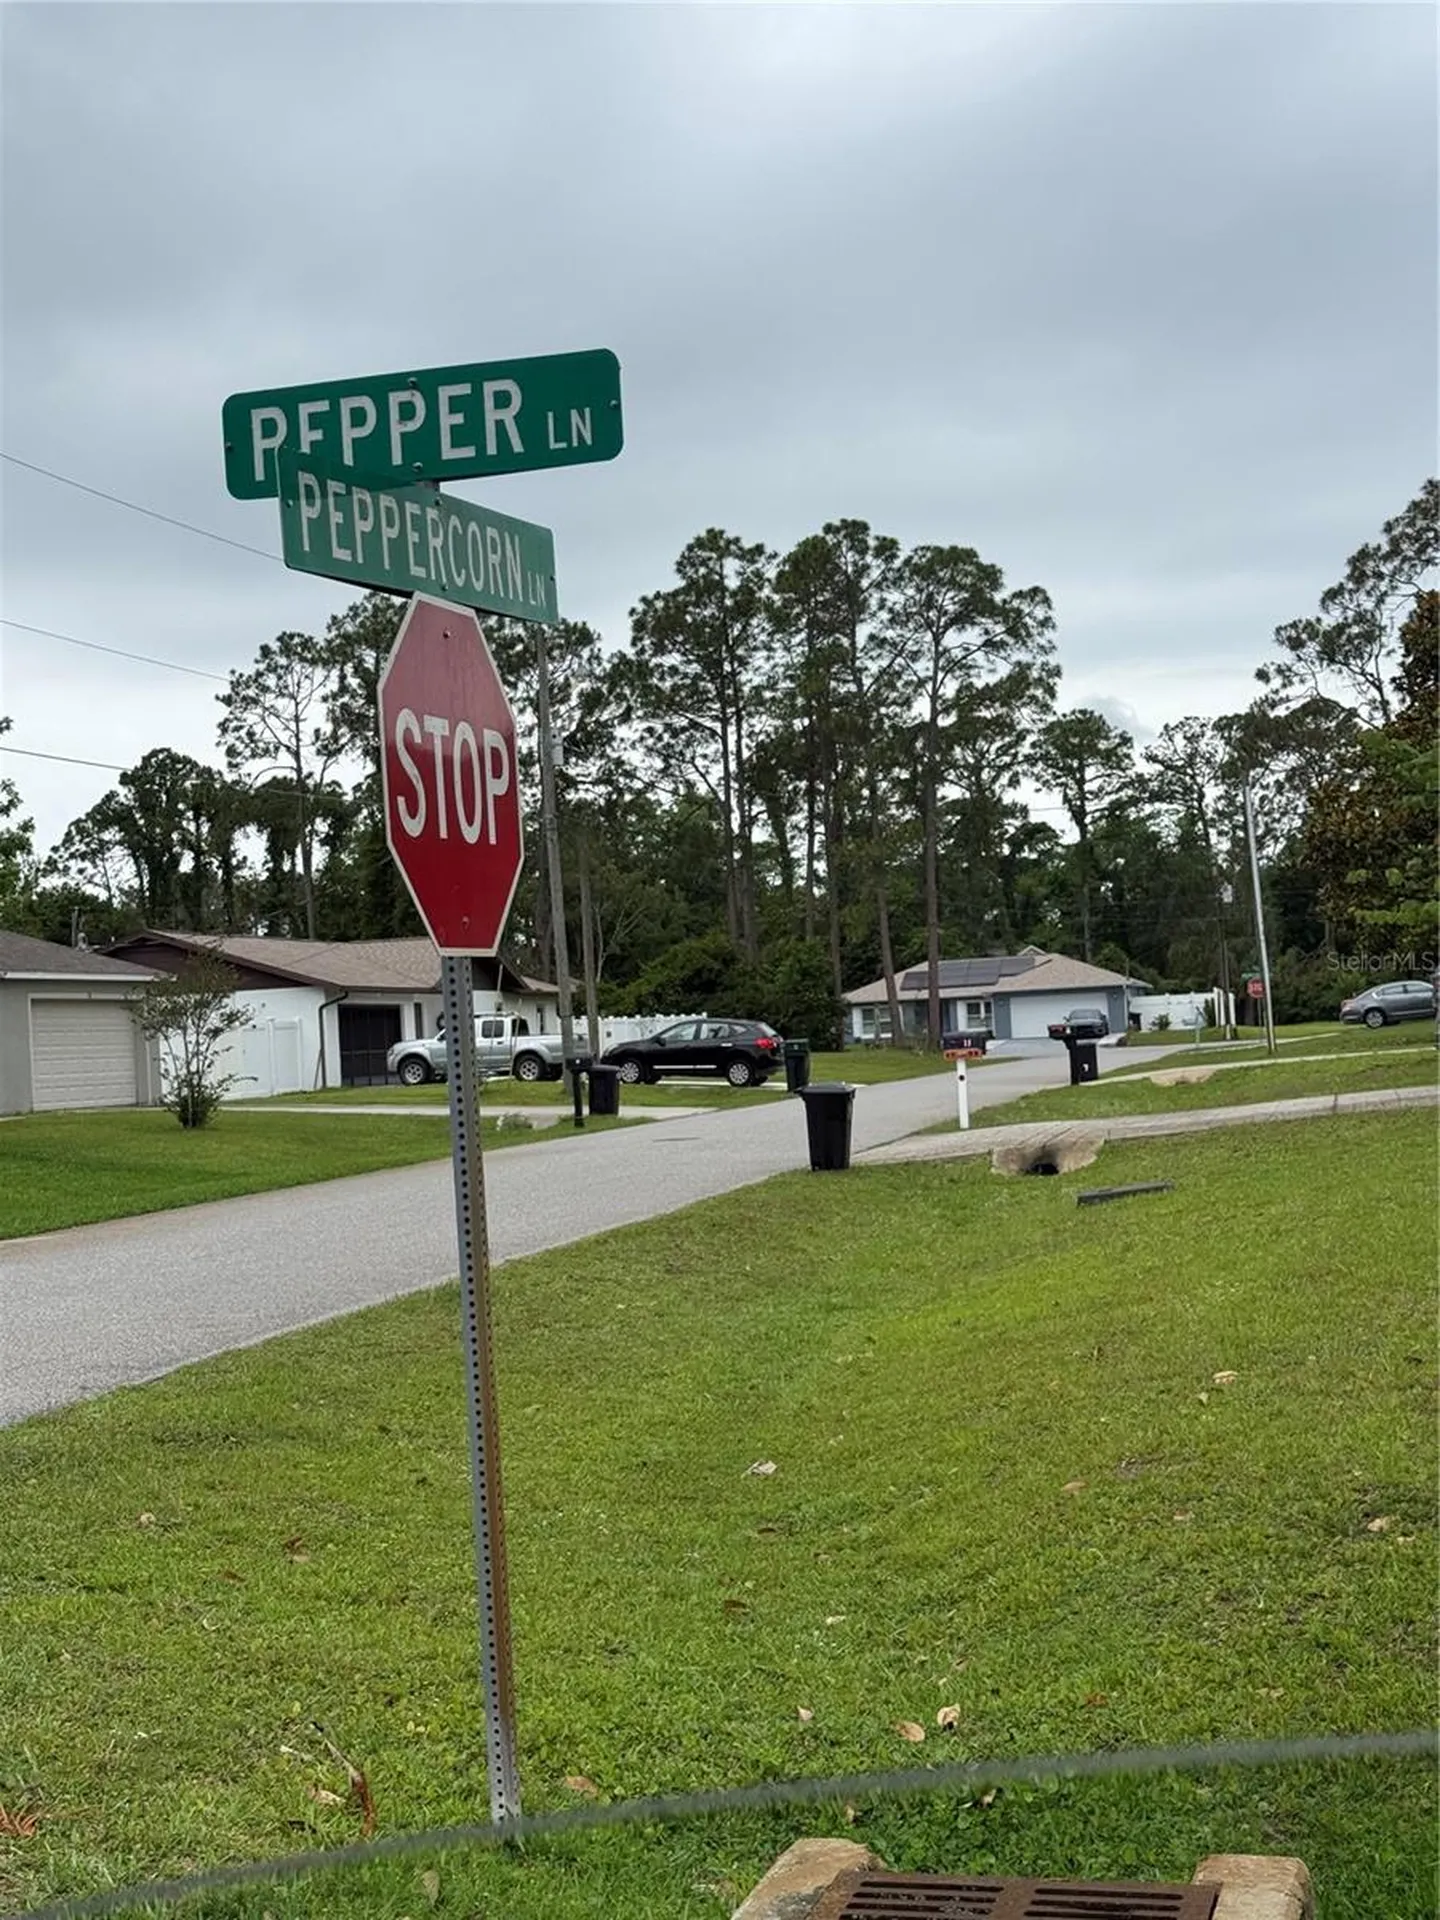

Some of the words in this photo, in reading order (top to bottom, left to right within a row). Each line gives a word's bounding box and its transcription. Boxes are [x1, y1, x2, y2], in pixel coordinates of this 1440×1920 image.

[250, 379, 525, 482] PEPPER
[547, 407, 593, 450] LN
[297, 470, 524, 602] PEPPERCORN
[527, 578, 547, 607] LN
[395, 707, 509, 845] STOP
